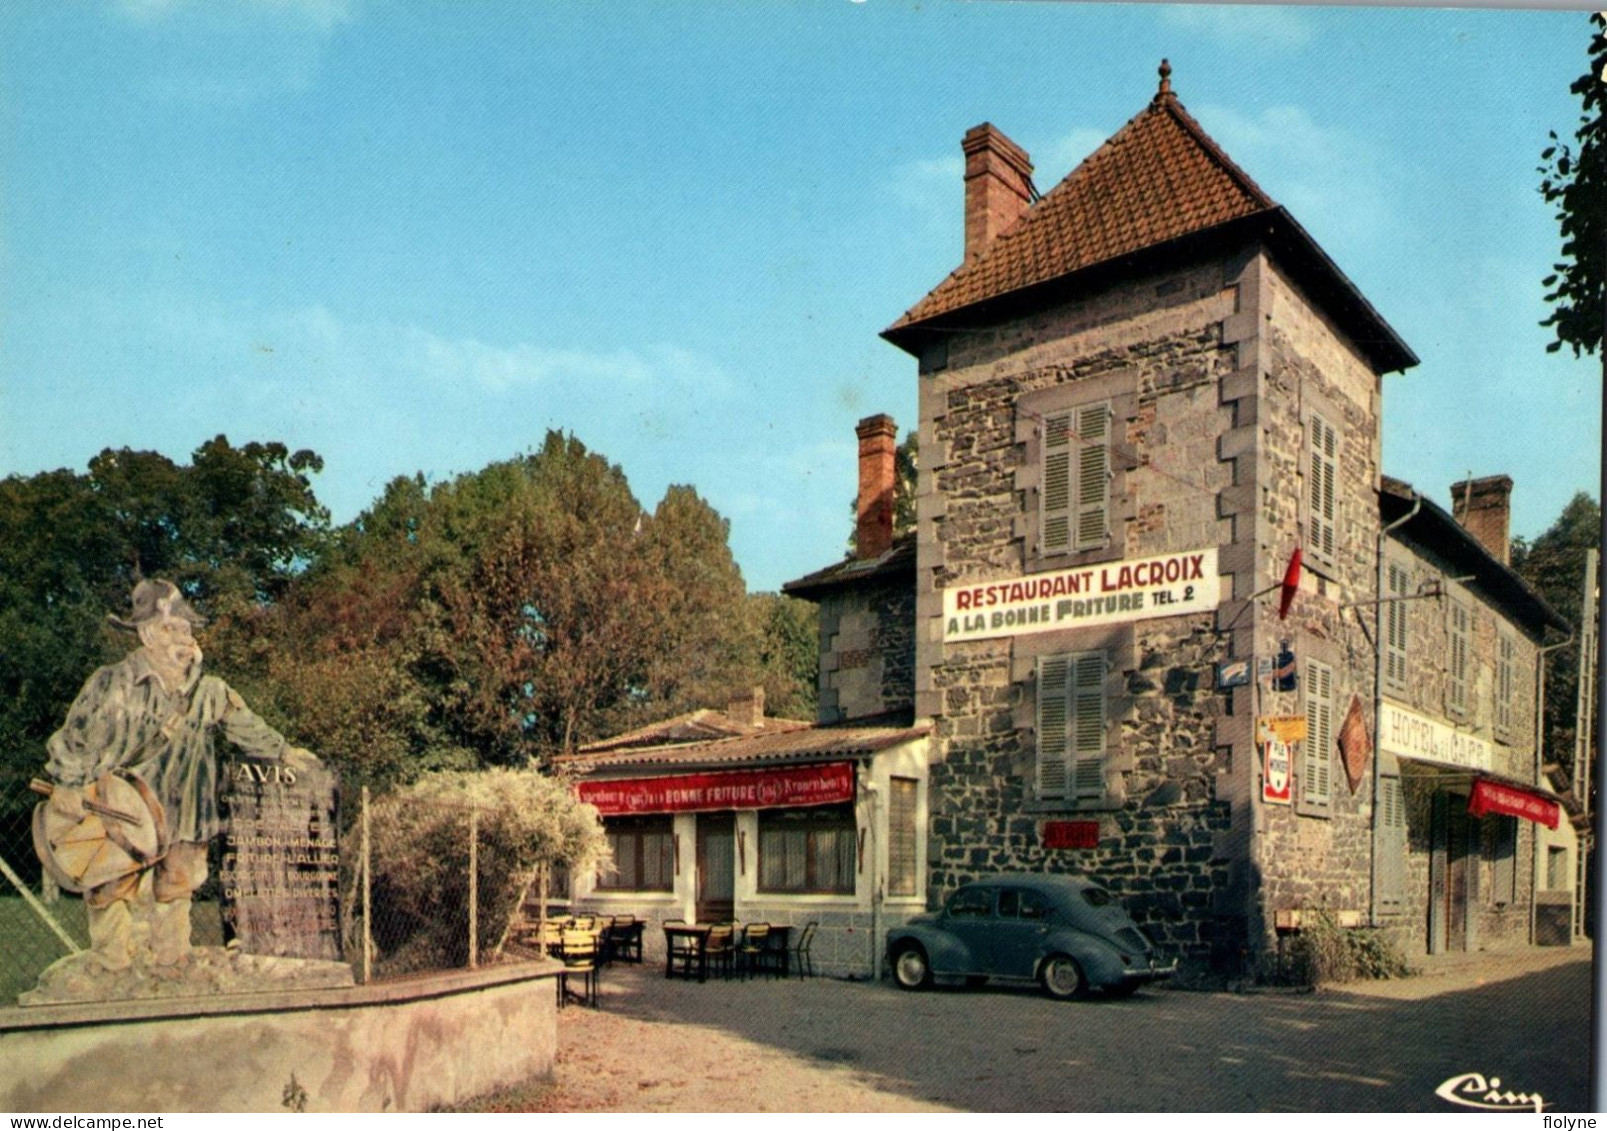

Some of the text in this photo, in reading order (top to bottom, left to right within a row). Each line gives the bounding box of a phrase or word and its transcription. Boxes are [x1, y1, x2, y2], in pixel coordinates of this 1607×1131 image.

[956, 554, 1204, 610] RESTAURANT LACROIX
[946, 586, 1194, 635] A LA BONNE FRITURE TEL. 2
[1392, 711, 1437, 756] HOTEL
[237, 763, 297, 785] AVIS
[665, 788, 703, 804] BONNE
[706, 785, 756, 802] FRITURE
